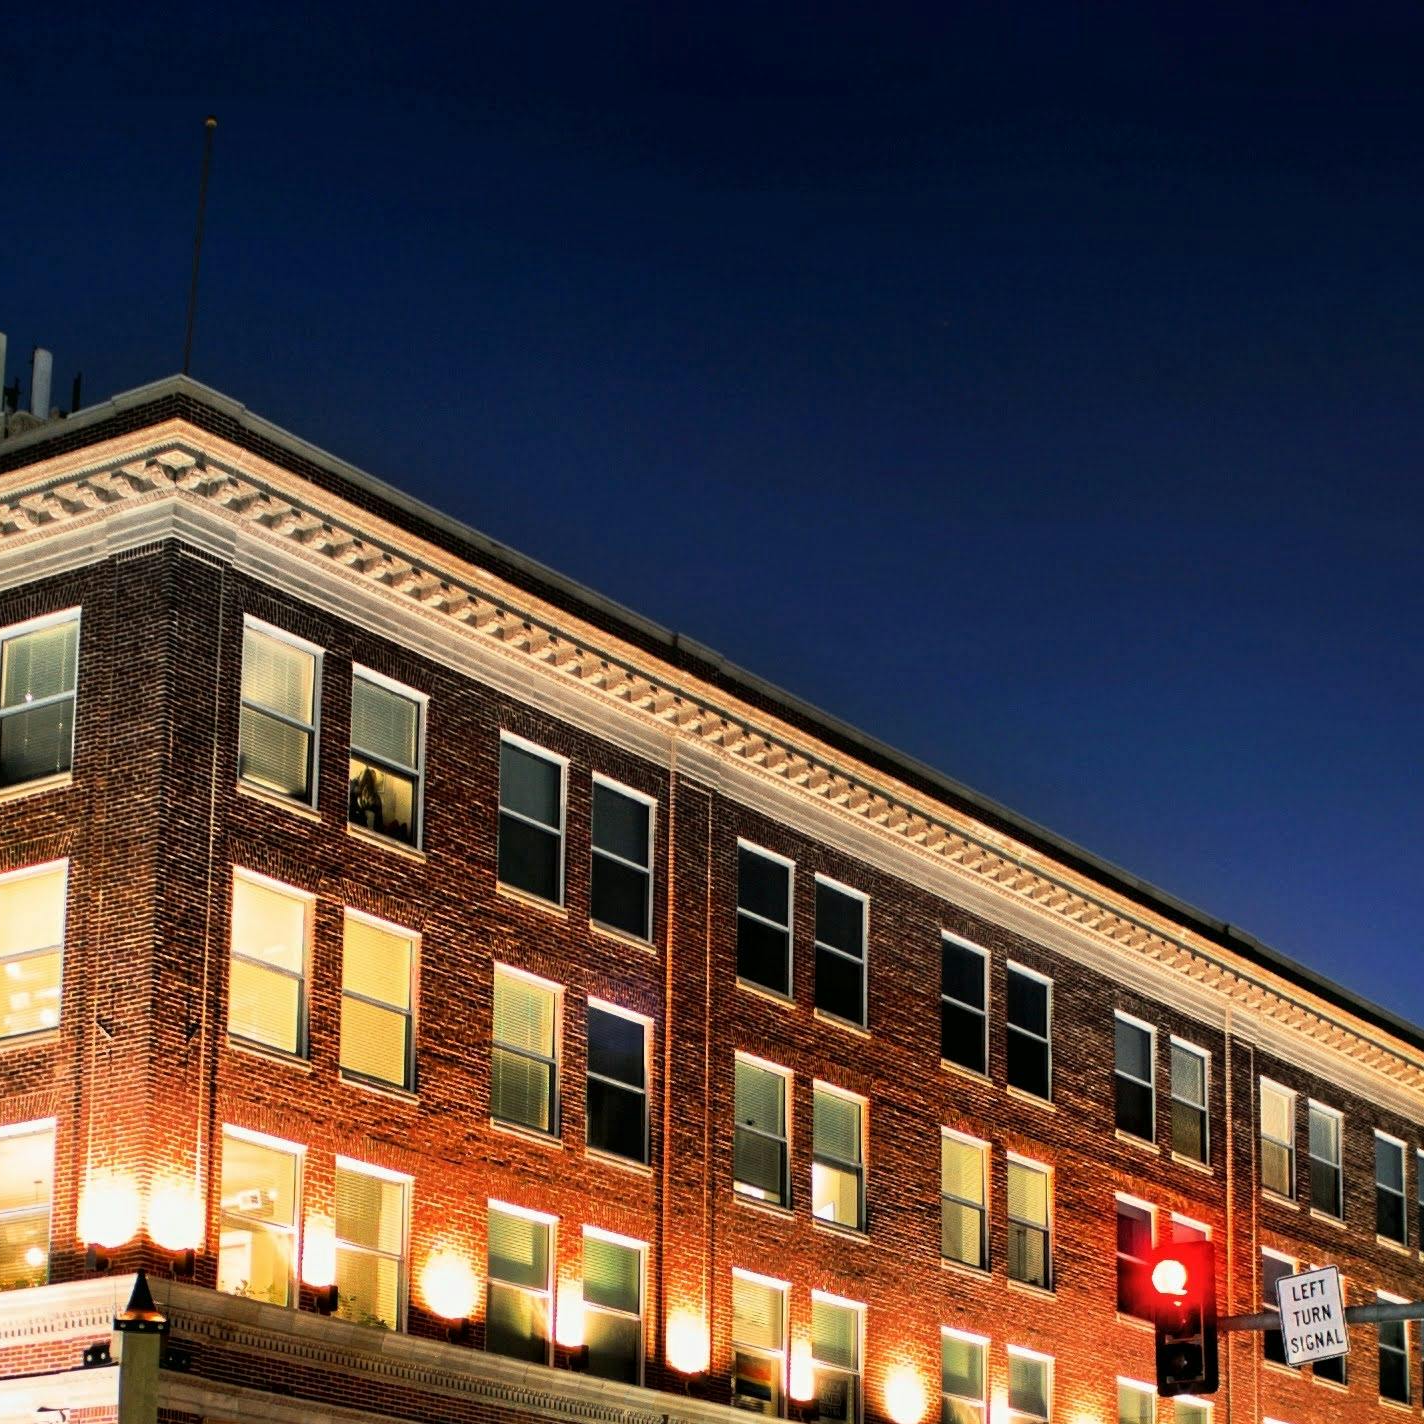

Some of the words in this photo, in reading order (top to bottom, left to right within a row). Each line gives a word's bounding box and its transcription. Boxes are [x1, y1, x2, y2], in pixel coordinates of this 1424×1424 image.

[1292, 1279, 1326, 1302] LEFT
[1293, 1304, 1332, 1327] TURN
[1290, 1328, 1344, 1354] SIGNAL
